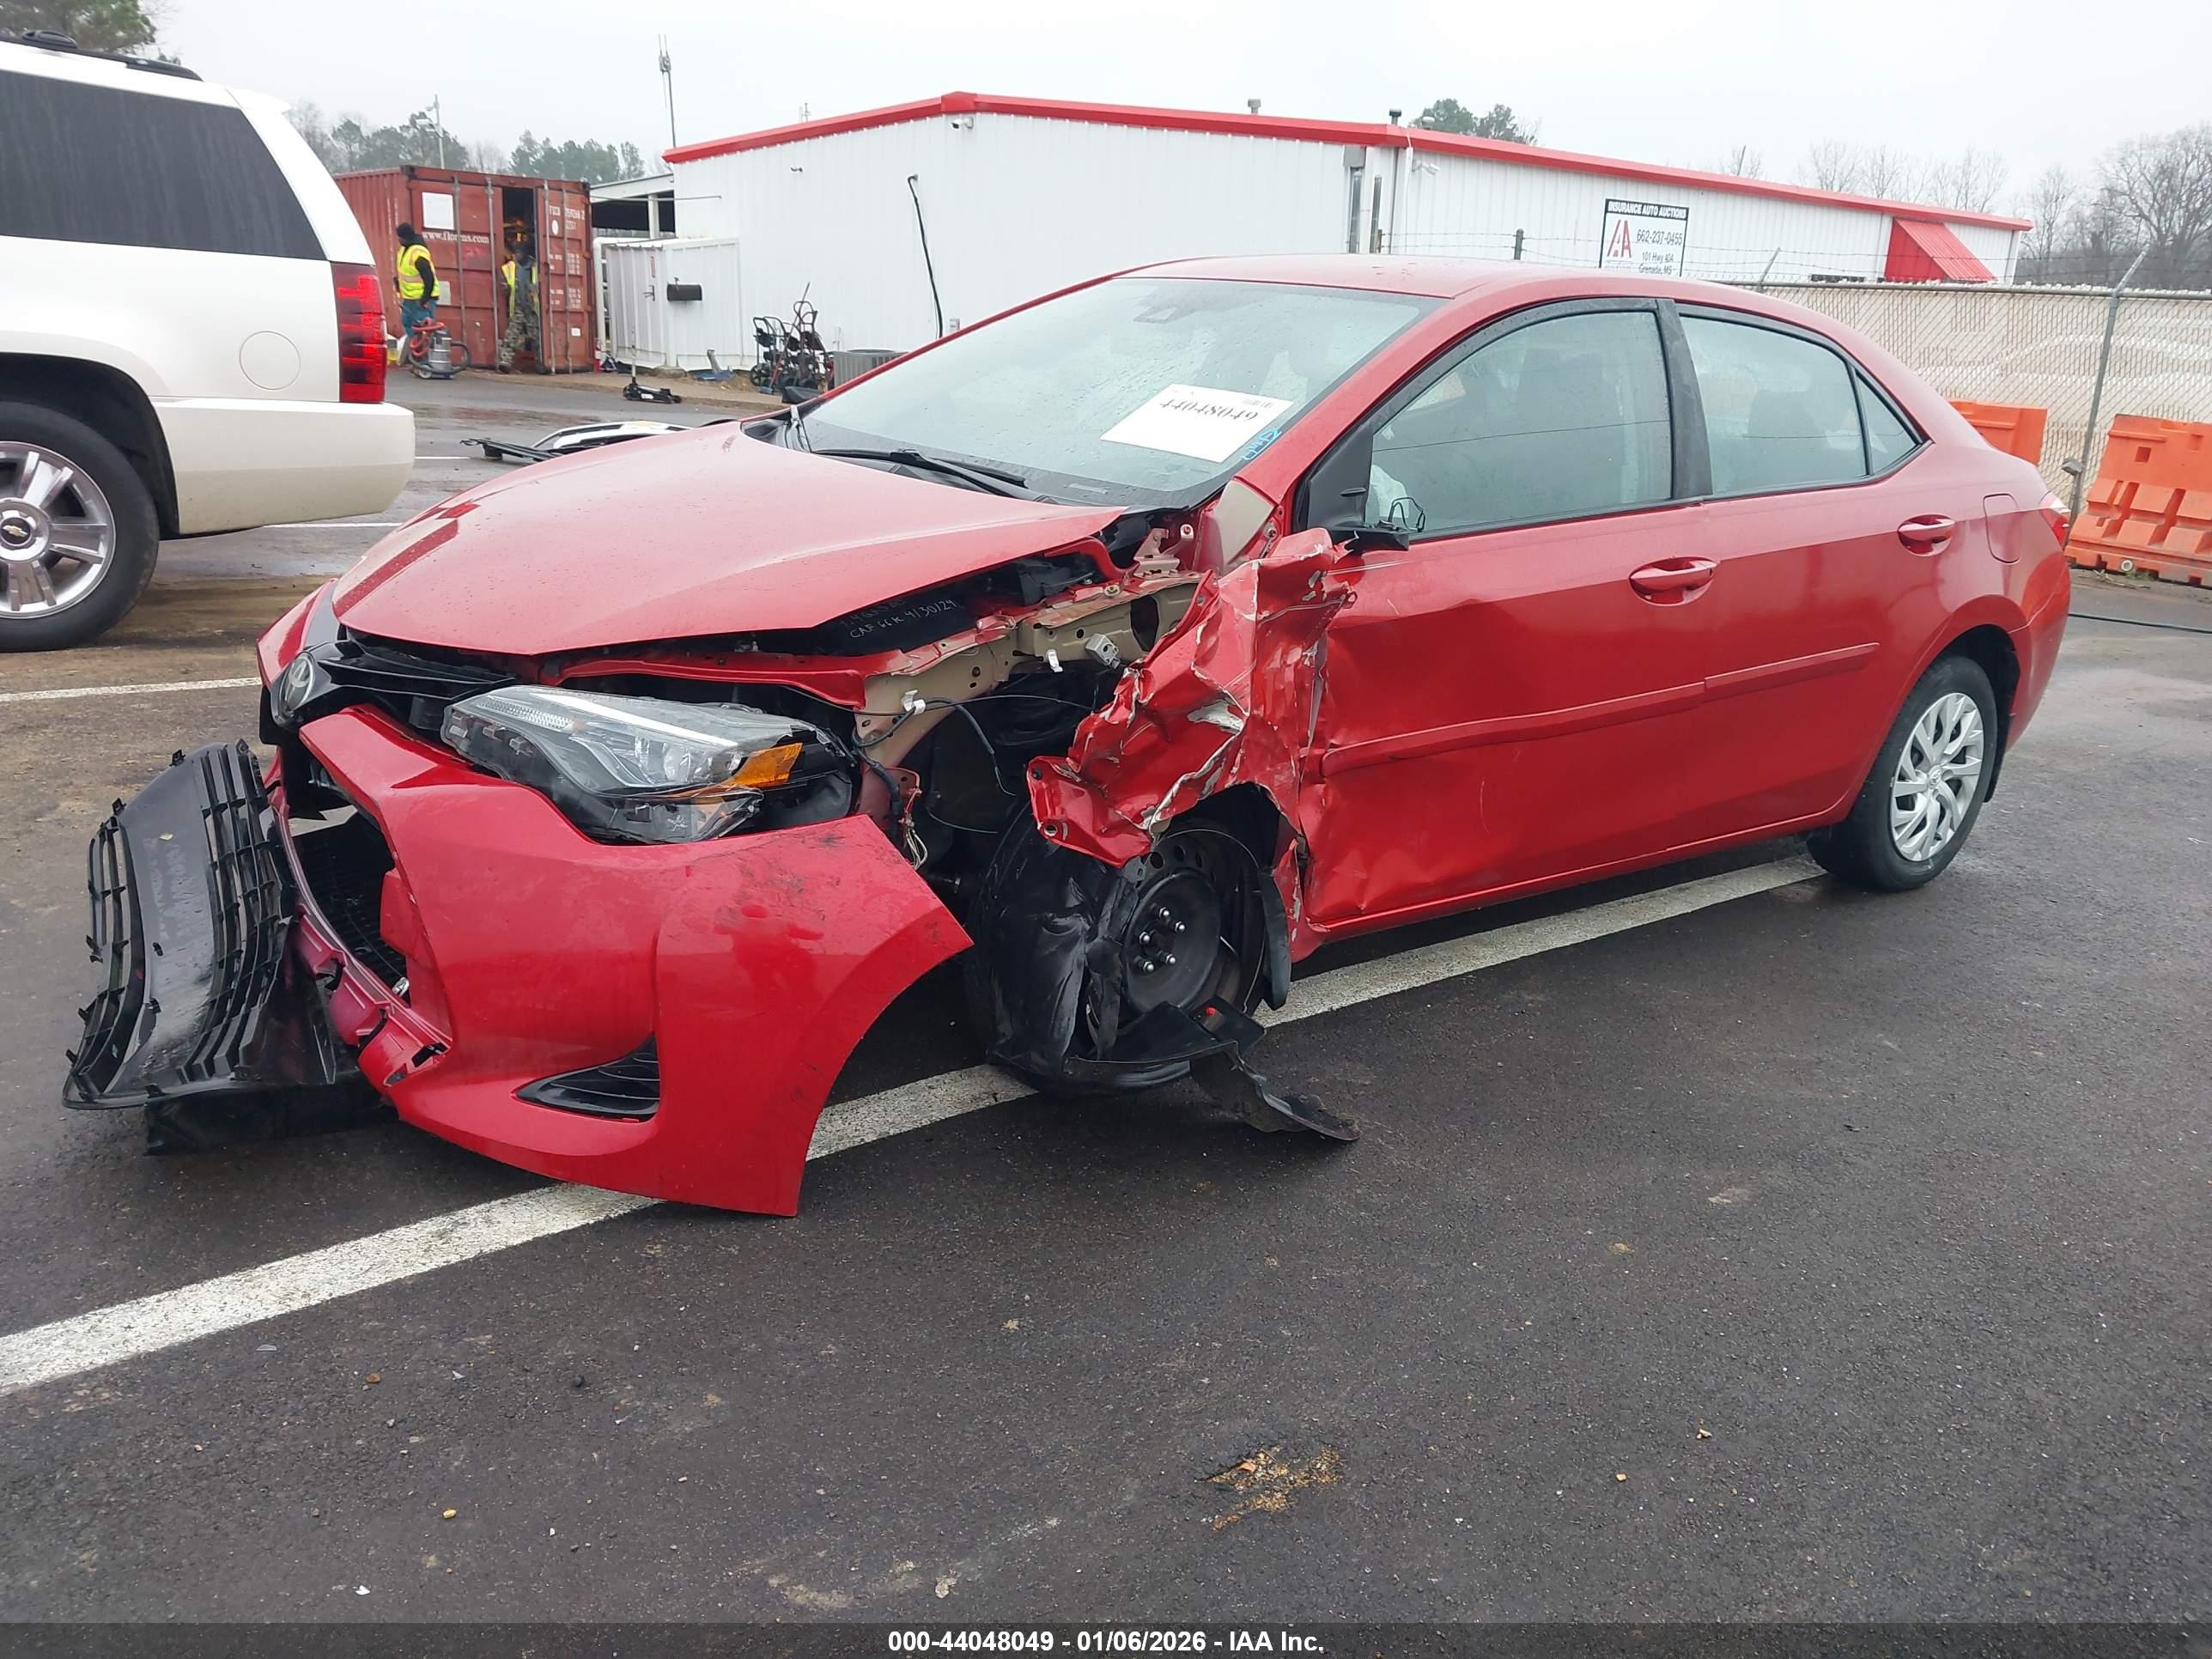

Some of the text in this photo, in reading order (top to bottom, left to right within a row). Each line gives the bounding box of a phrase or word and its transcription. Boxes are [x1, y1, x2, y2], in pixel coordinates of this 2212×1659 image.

[1607, 200, 1686, 219] INSURANCE AUTO AUCTIONS
[1637, 229, 1683, 246] 662-237-0455
[1652, 252, 1663, 264] Hwy
[1159, 398, 1259, 421] 44048049
